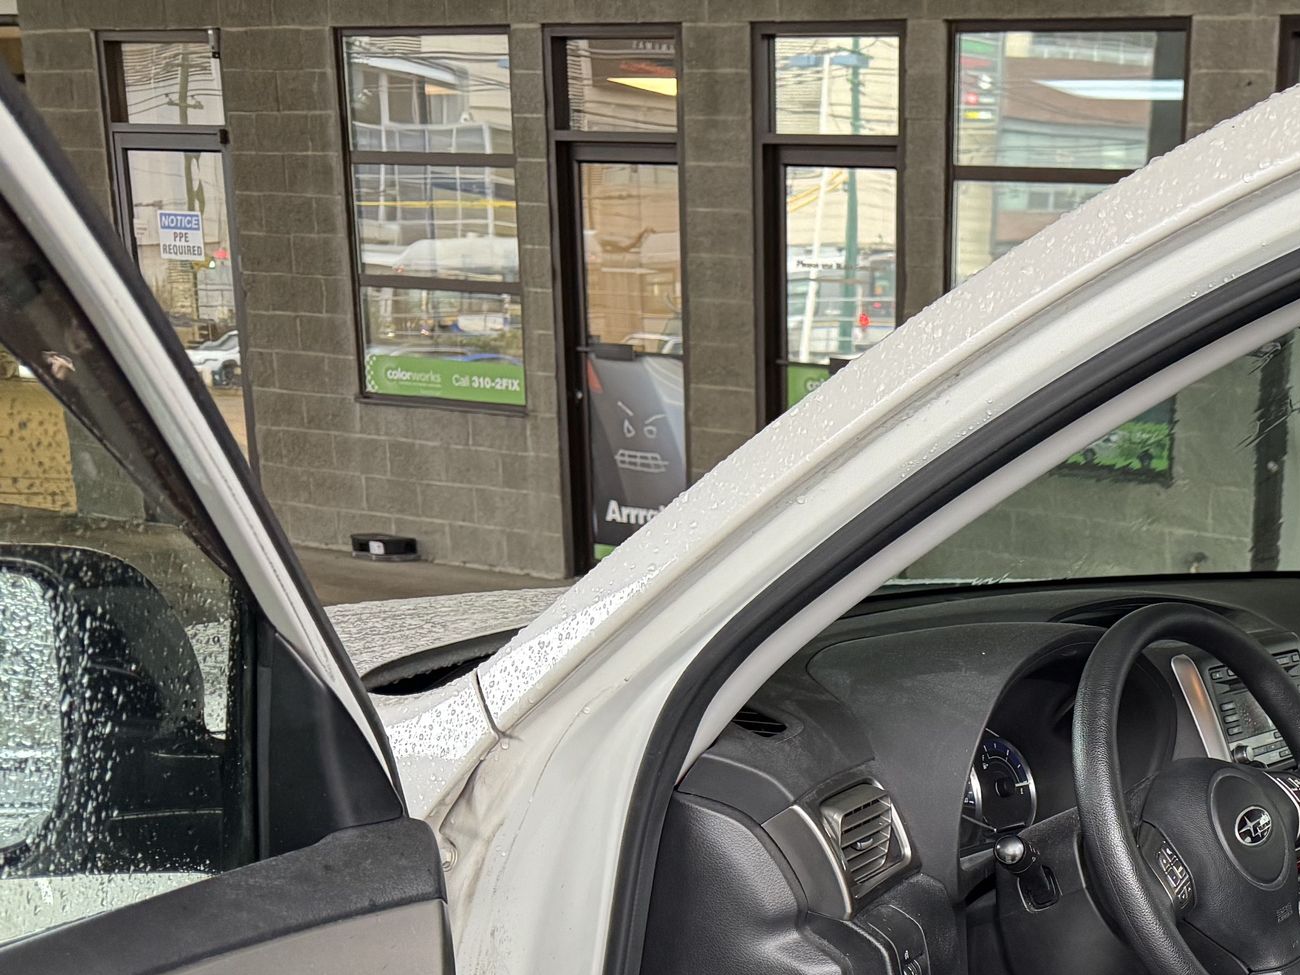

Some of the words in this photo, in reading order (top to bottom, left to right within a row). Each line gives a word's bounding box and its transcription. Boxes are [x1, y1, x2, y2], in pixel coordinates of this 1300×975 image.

[161, 215, 199, 228] NOTICE
[173, 231, 189, 242] PPE
[162, 243, 202, 256] REQUIRED
[387, 367, 441, 383] colorworks
[452, 374, 469, 387] Call
[471, 375, 520, 391] 310-2FIX
[605, 499, 667, 525] Arrr
